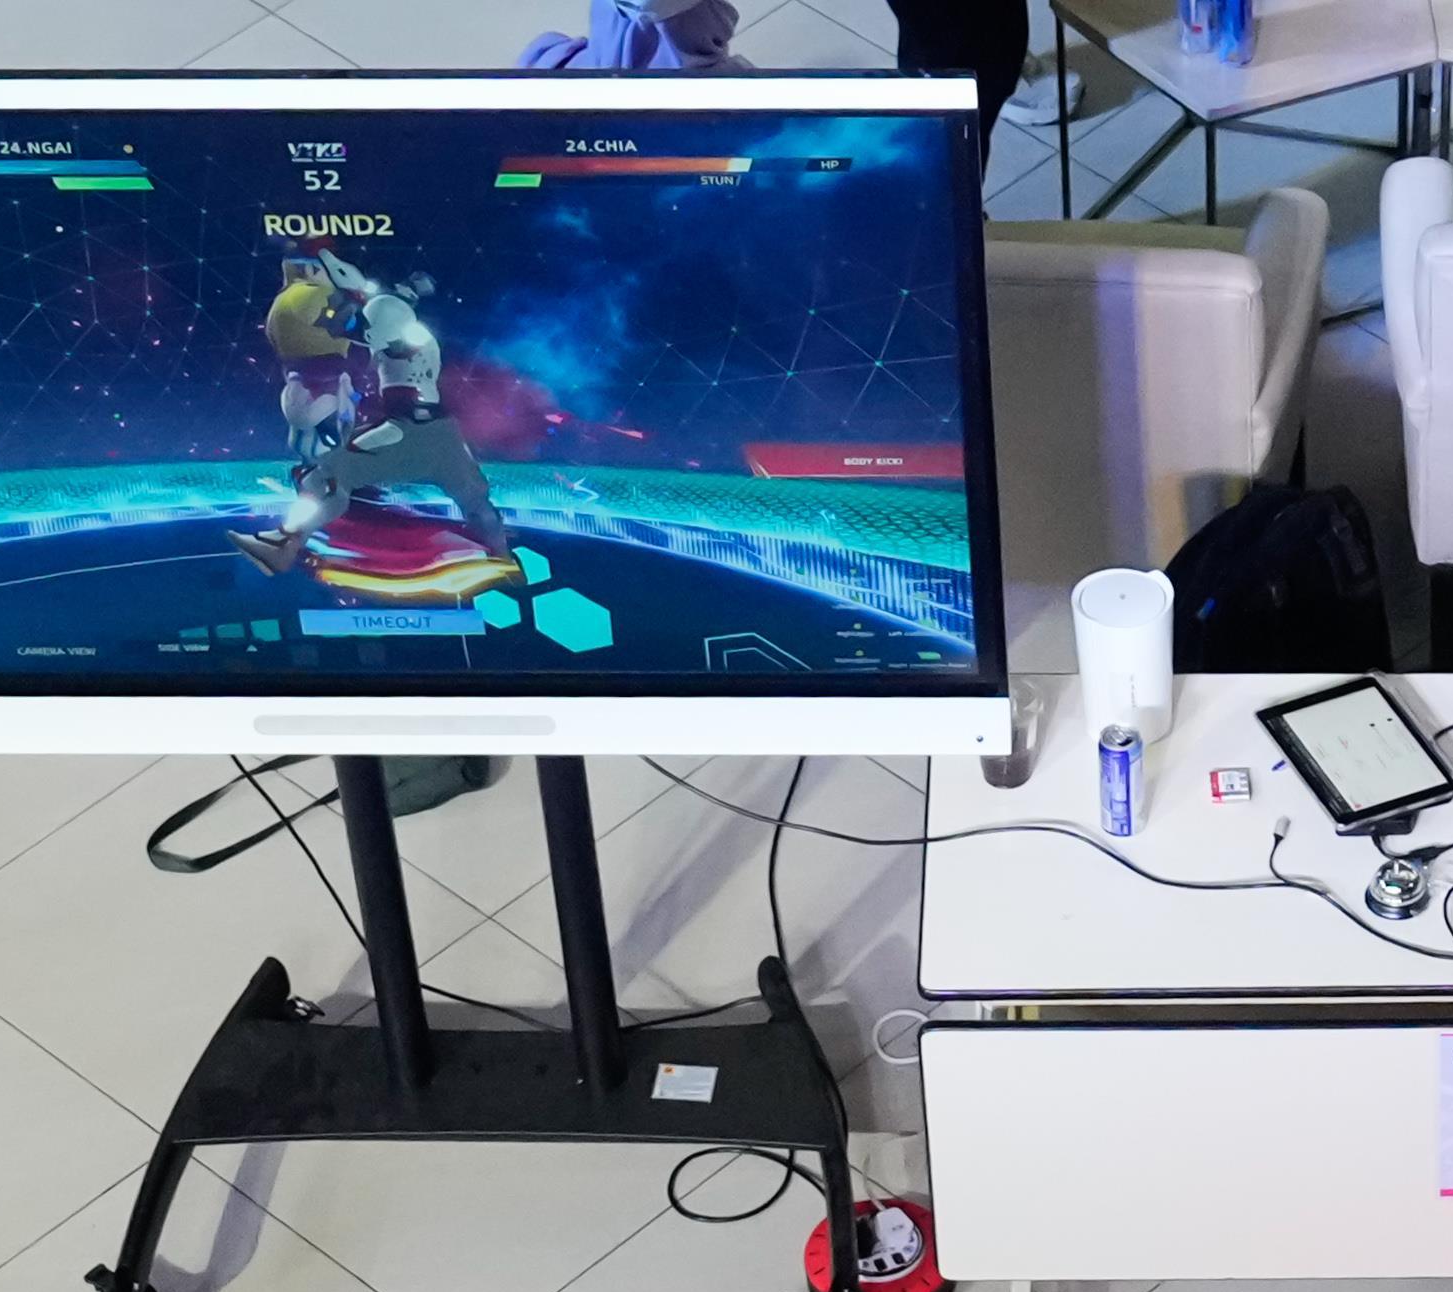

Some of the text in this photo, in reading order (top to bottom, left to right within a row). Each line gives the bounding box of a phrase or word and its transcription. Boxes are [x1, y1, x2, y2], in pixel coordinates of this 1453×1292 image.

[0, 141, 73, 155] 24.NGAI
[565, 139, 638, 153] 24.CHIA
[820, 159, 840, 169] HP
[304, 169, 342, 191] 52
[700, 175, 734, 186] STUN
[263, 213, 395, 237] ROUND2
[353, 615, 432, 629] TIMEOUT
